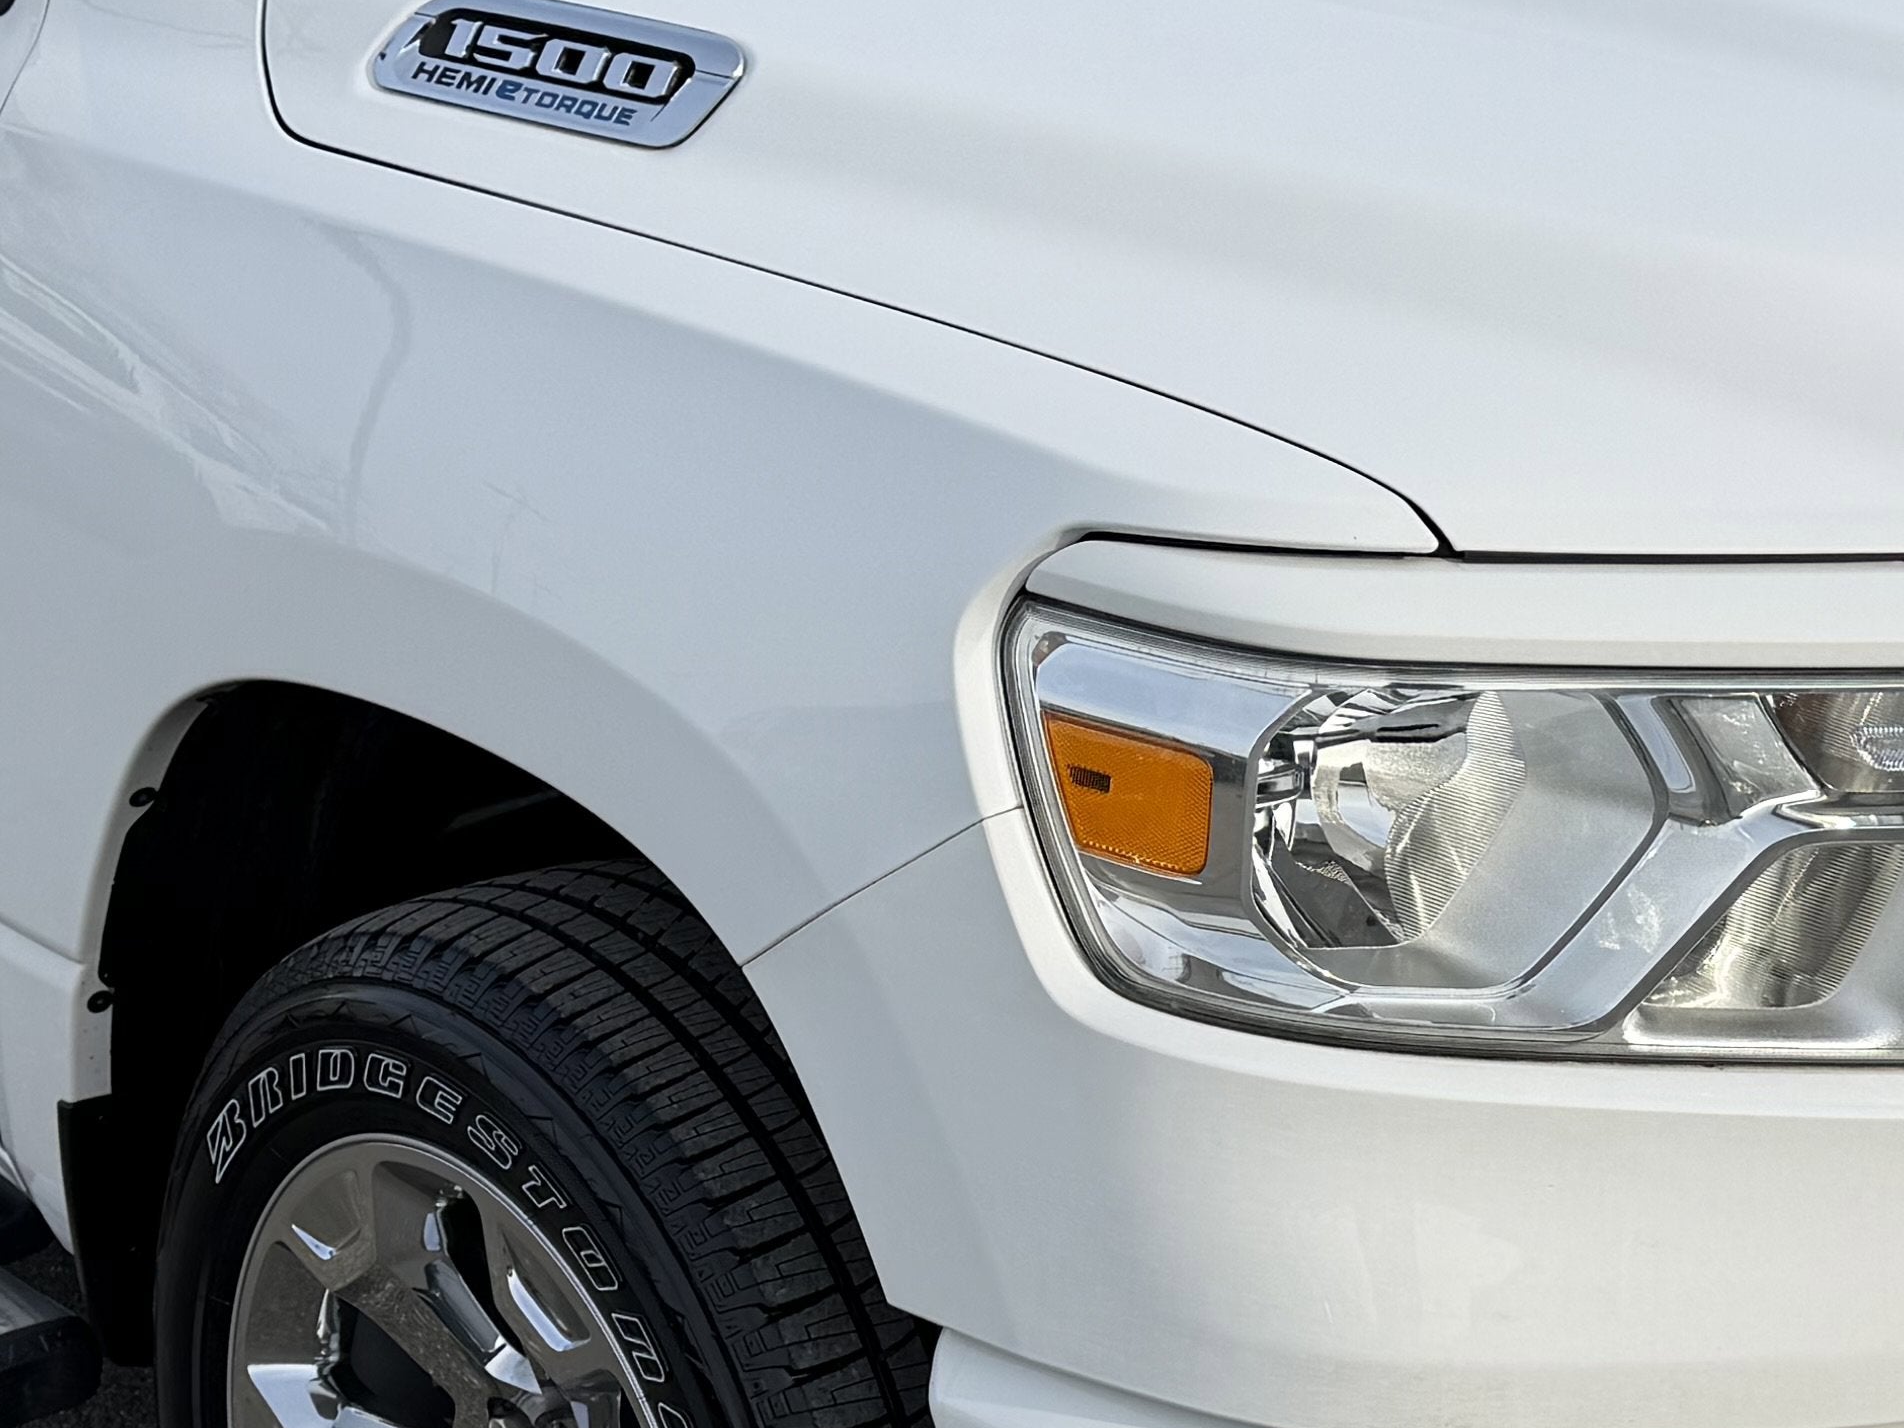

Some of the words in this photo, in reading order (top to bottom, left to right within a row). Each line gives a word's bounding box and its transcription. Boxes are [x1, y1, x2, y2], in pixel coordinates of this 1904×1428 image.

[411, 60, 496, 97] HEMI
[495, 79, 638, 127] eTORQUE
[444, 17, 683, 98] 1500
